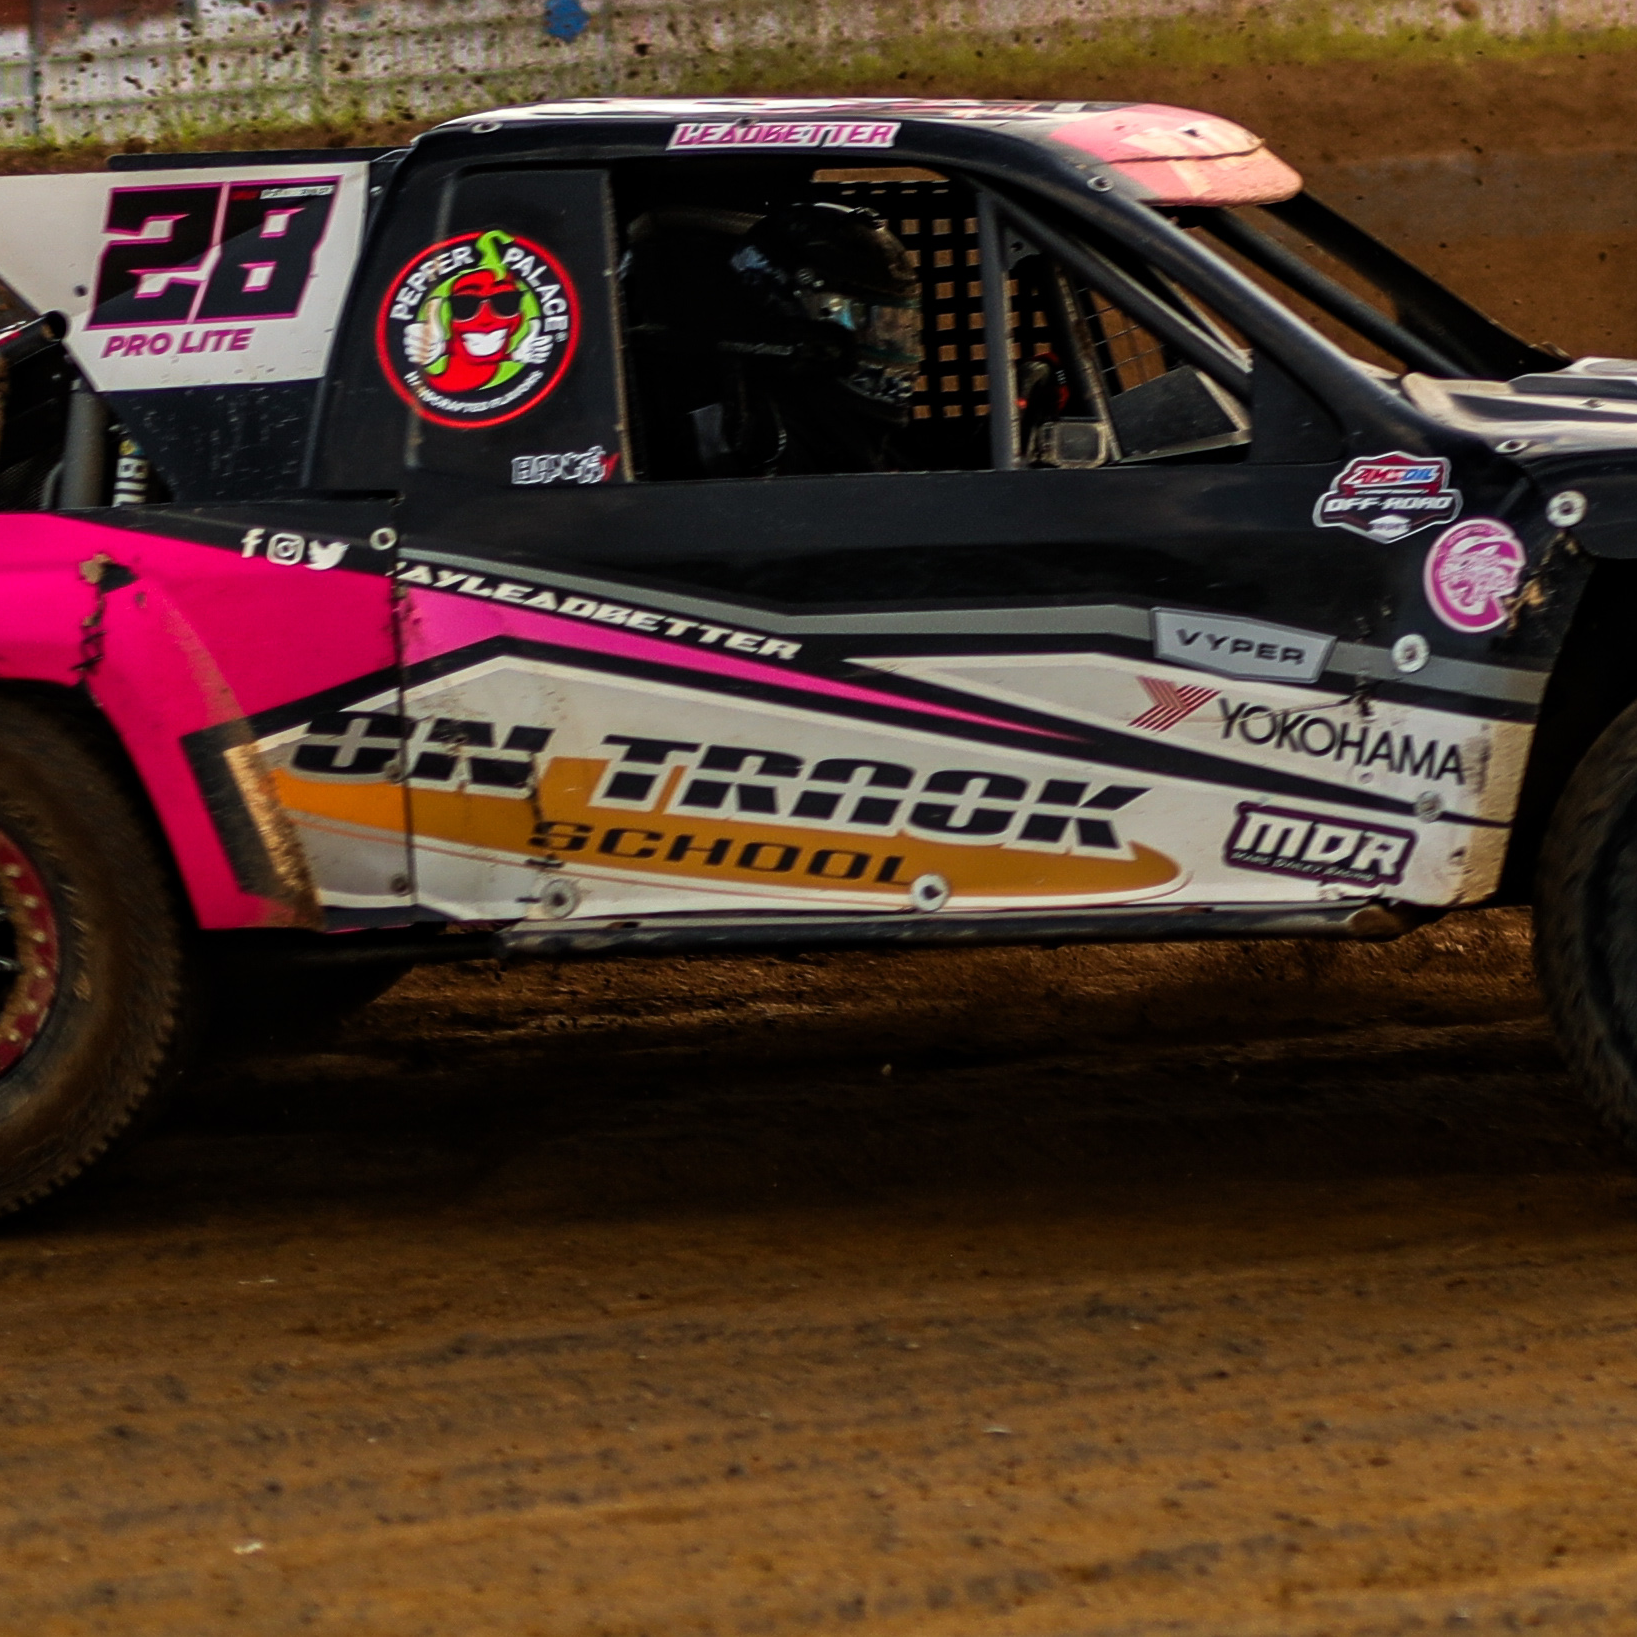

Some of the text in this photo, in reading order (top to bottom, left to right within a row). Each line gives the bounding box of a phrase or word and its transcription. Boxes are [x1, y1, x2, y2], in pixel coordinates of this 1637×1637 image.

[670, 123, 899, 147] LEADBETTER
[83, 174, 344, 331] 28
[389, 245, 569, 333] PEPPER PALACE
[100, 327, 257, 359] PRO LITE
[1347, 466, 1439, 485] AMSOIL
[1176, 628, 1308, 666] VYPER
[291, 709, 556, 801] ON
[1217, 697, 1467, 786] YOKOHAMA
[528, 819, 915, 887] SCHOOL
[1232, 811, 1411, 877] MDR
